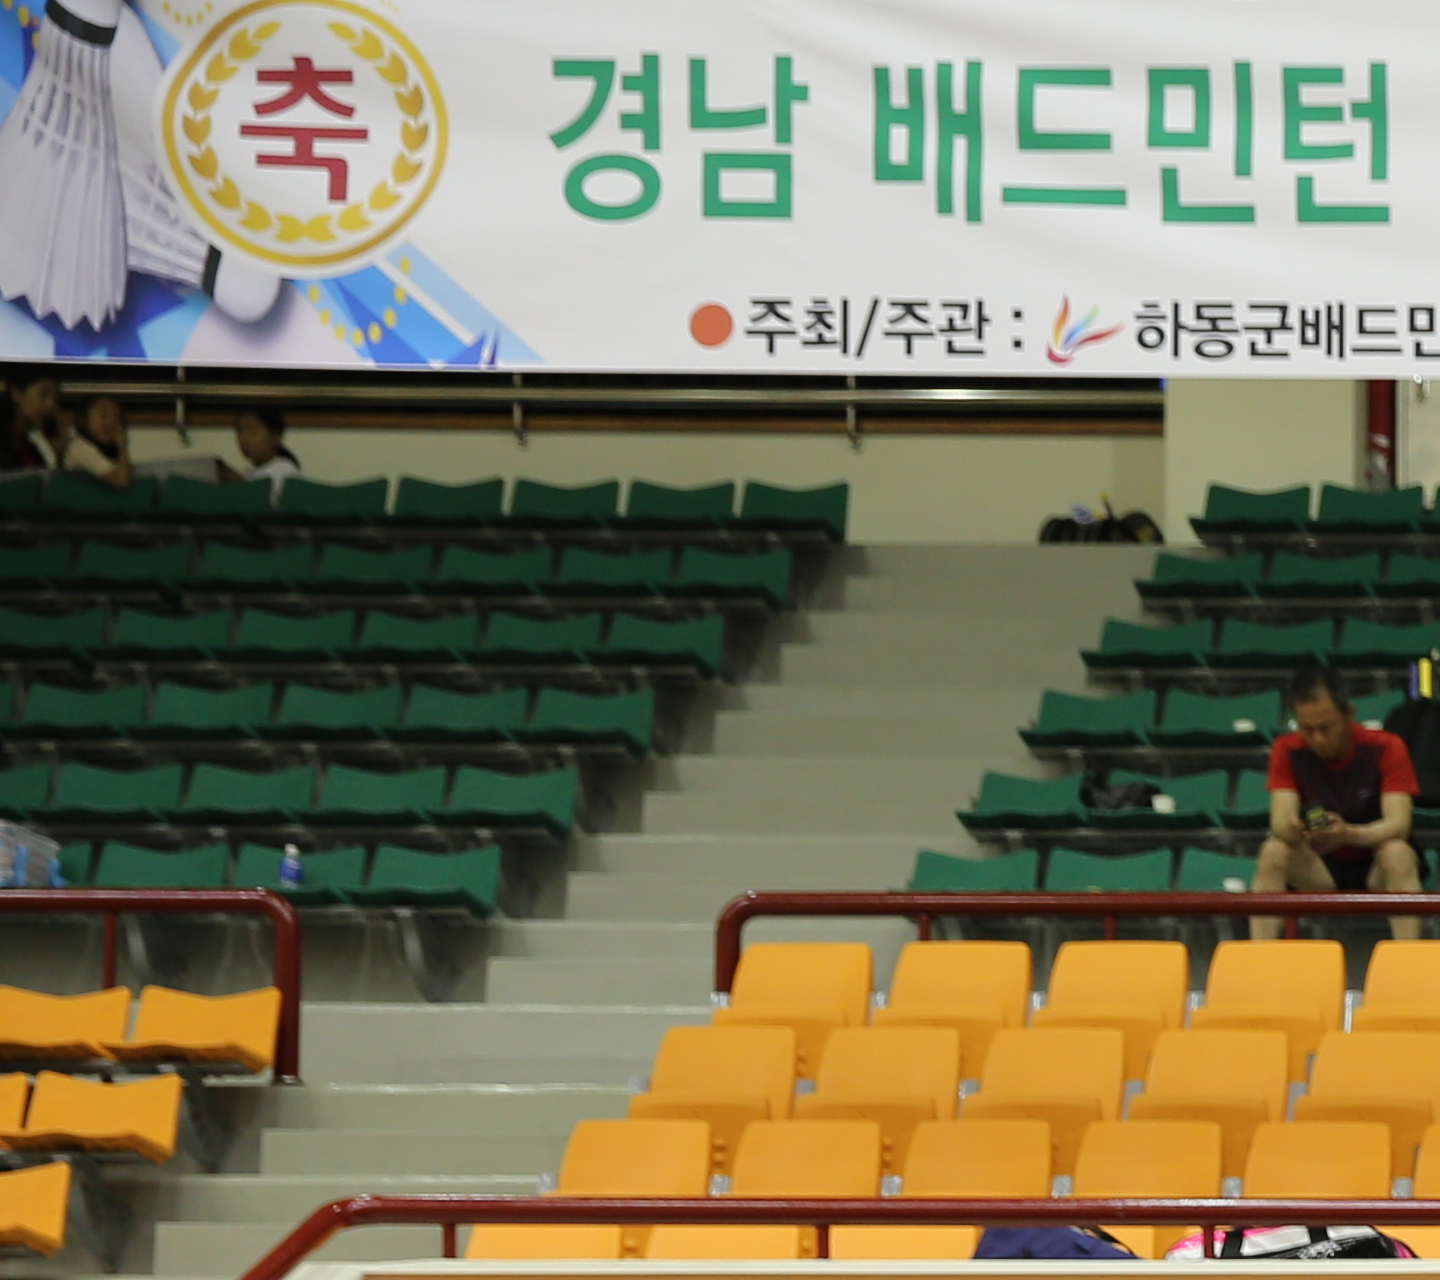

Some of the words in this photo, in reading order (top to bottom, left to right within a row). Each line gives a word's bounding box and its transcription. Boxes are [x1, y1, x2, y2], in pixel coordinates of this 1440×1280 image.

[240, 55, 368, 203] 축
[550, 53, 810, 223] 경남
[873, 61, 1392, 226] 배드민턴
